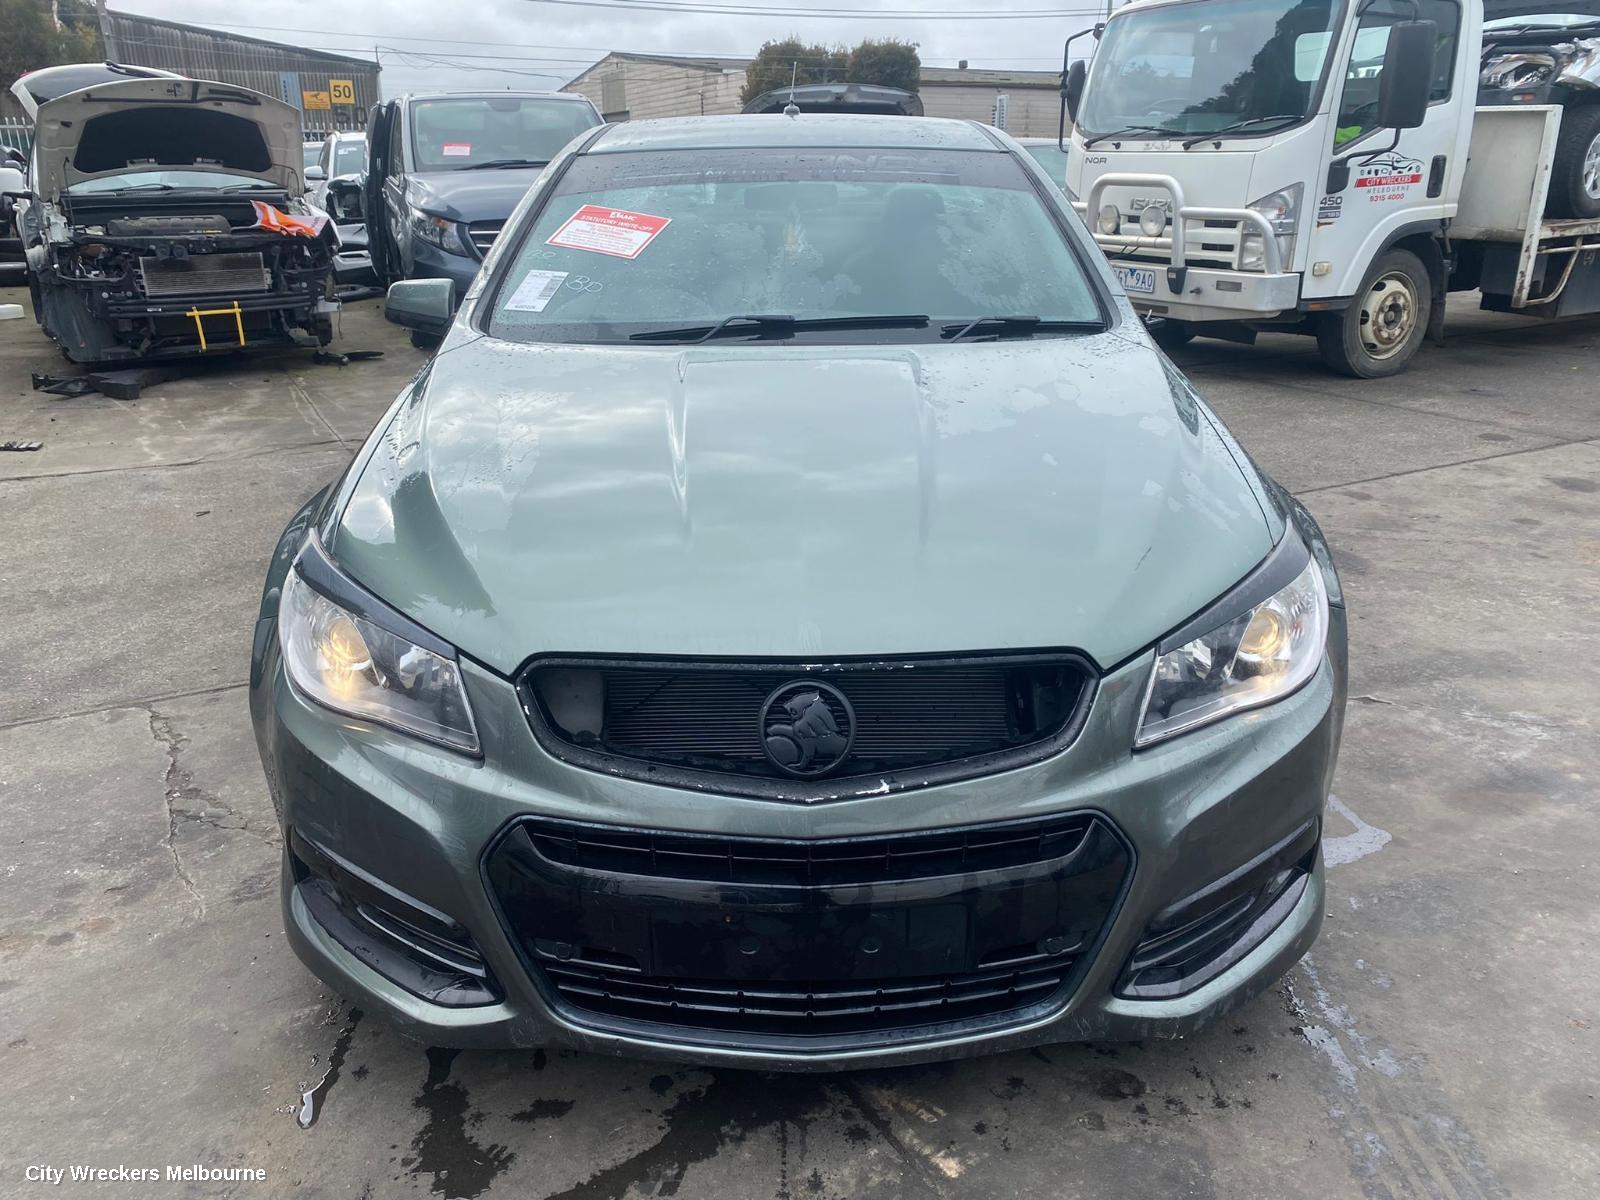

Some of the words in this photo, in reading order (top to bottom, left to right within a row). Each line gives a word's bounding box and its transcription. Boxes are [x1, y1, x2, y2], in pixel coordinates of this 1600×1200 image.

[333, 85, 352, 98] 50
[1366, 178, 1381, 186] CITY
[1381, 175, 1412, 185] WRECKERS
[1320, 196, 1342, 206] 450
